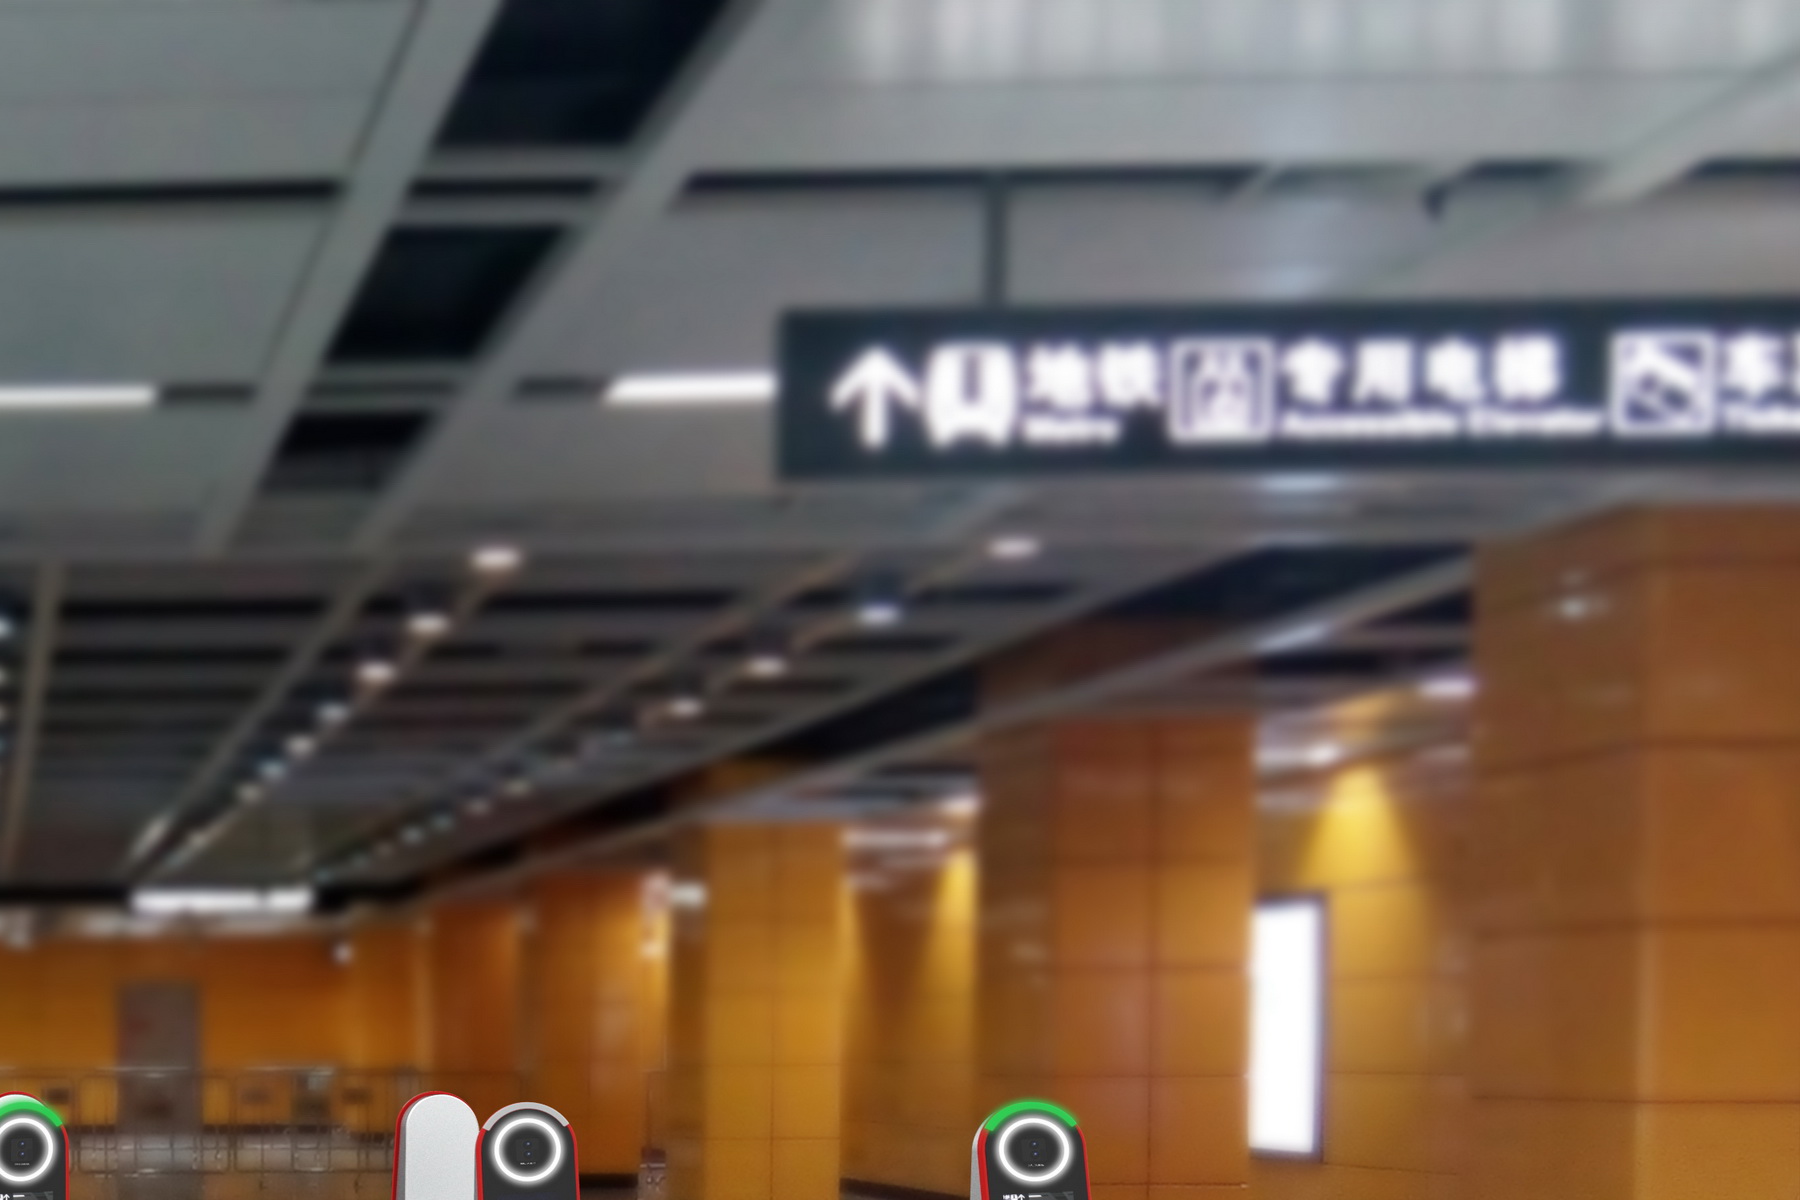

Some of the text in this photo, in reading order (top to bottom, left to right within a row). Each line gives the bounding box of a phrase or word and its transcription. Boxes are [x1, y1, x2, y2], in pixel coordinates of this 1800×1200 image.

[1026, 332, 1800, 406] 地铁 专用电梯 车
